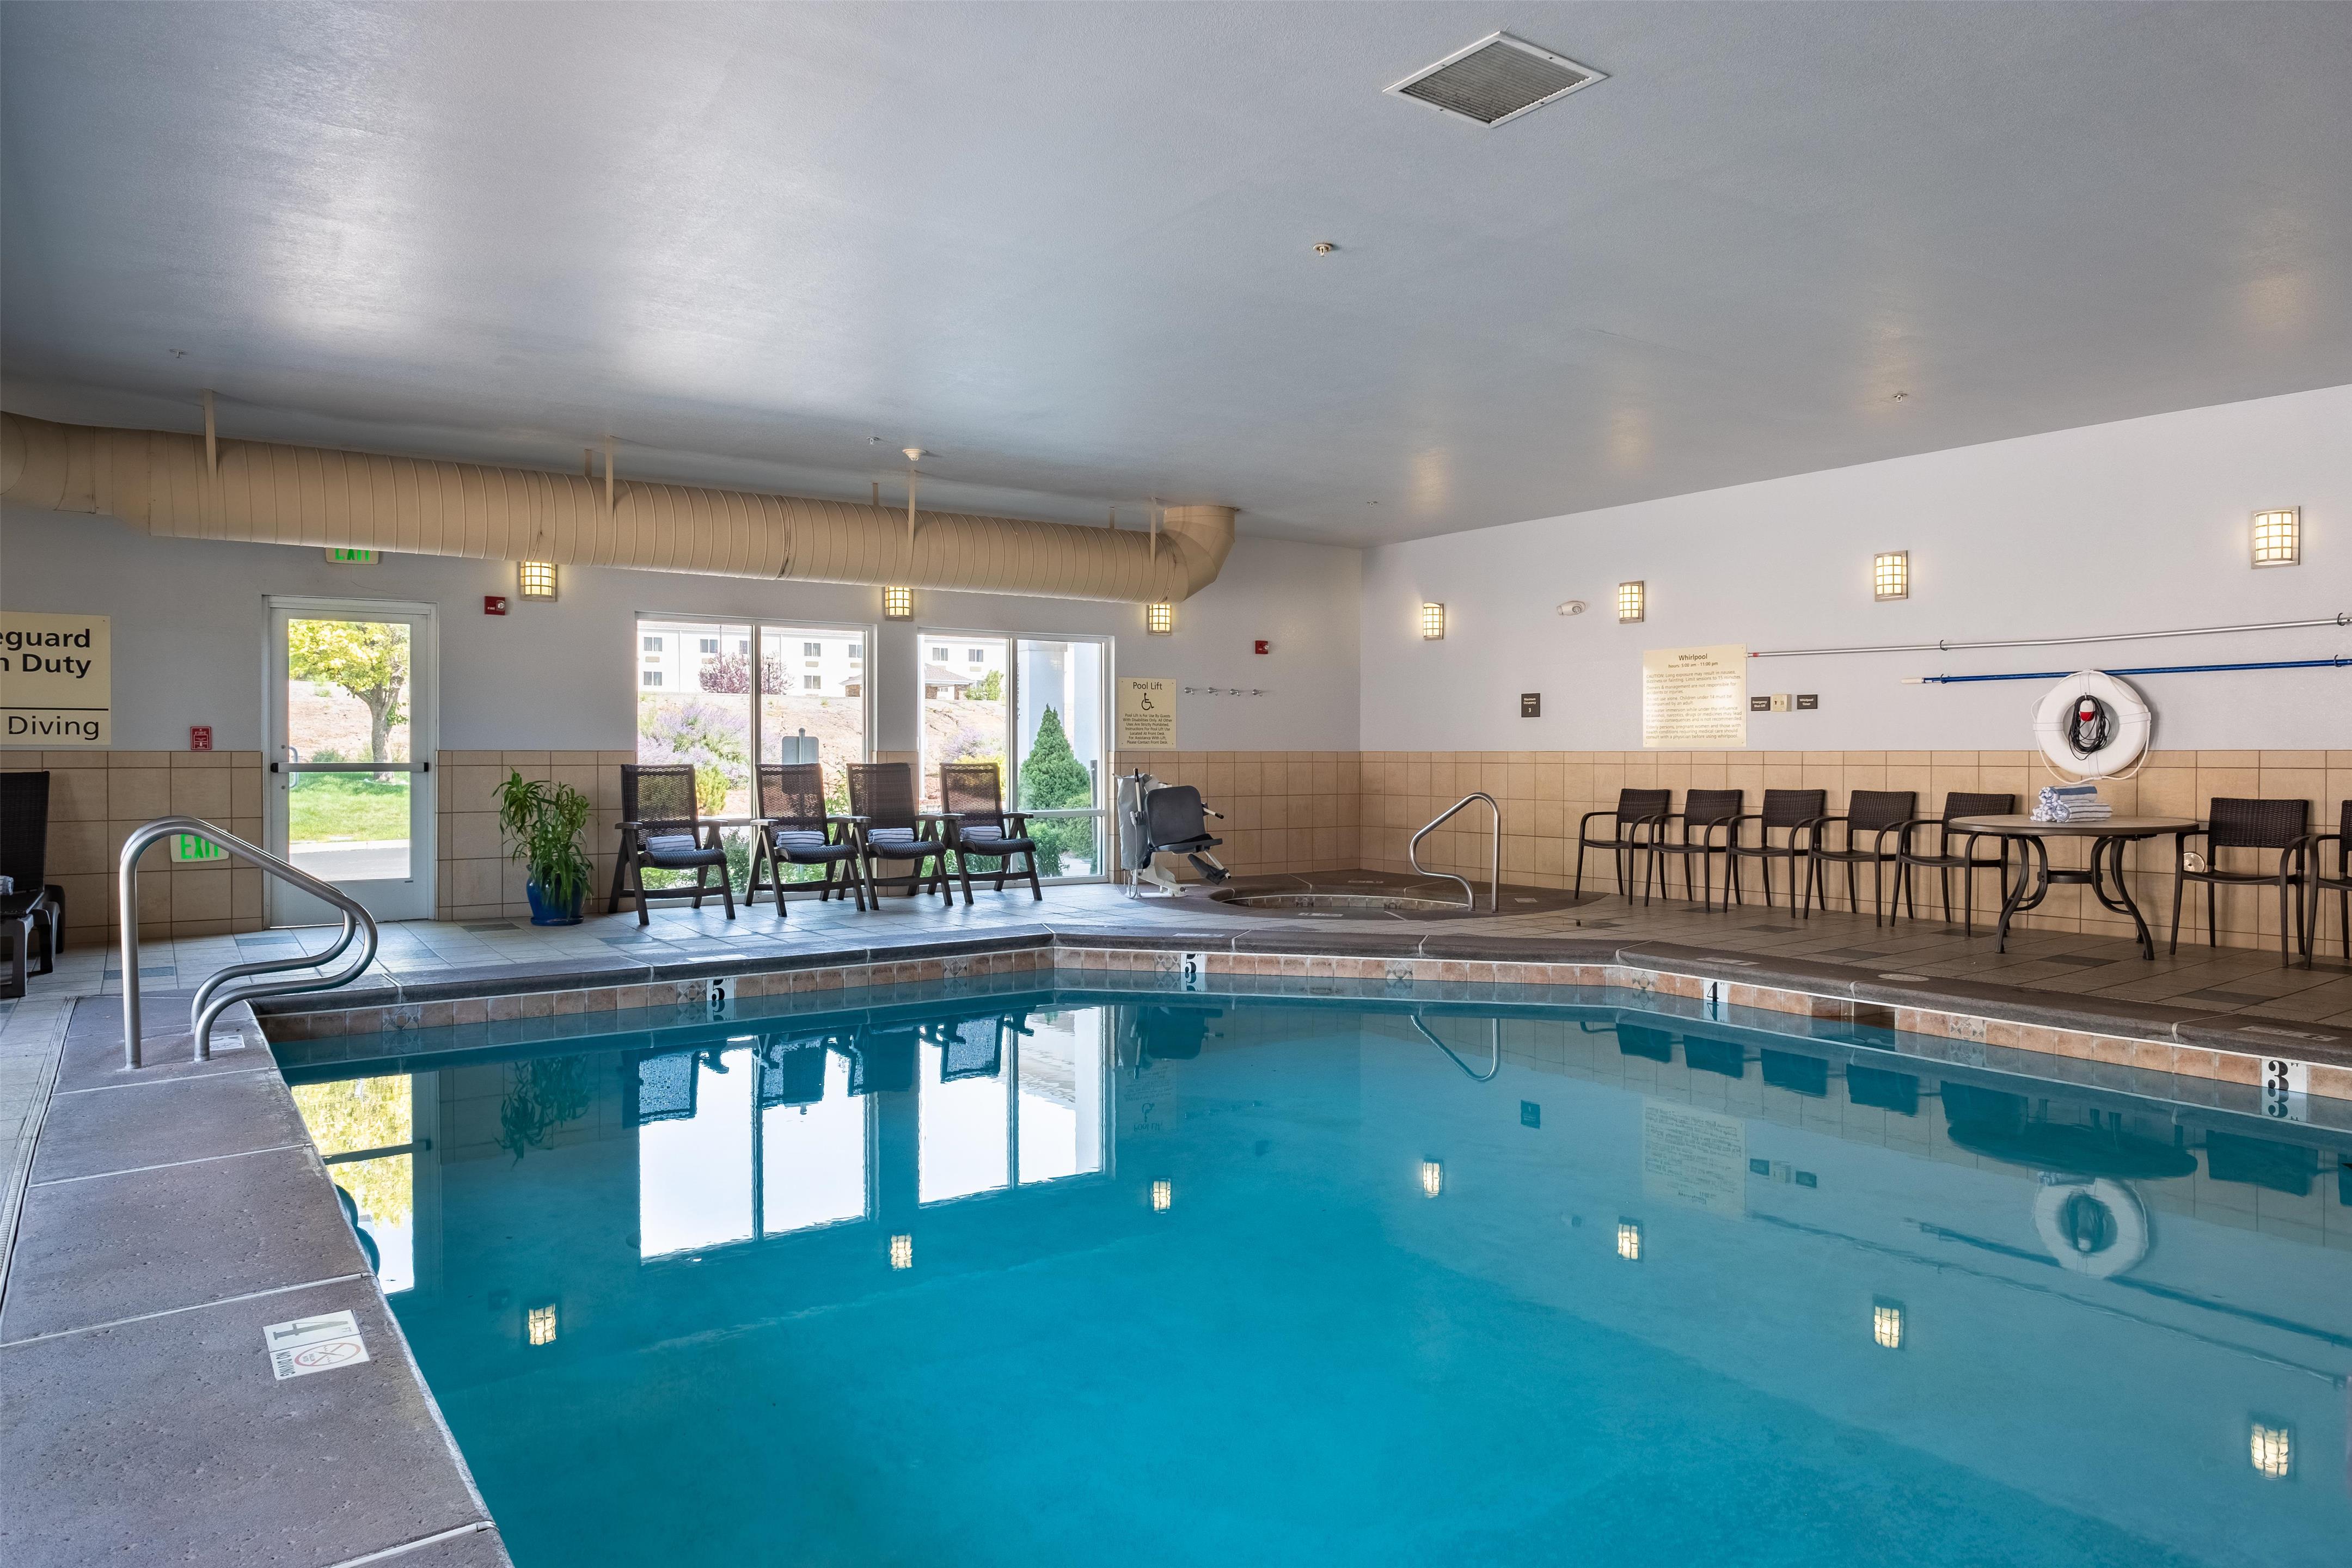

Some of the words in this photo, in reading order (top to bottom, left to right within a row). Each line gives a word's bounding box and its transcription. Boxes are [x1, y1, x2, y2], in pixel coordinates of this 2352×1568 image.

[0, 629, 90, 651] guard
[22, 653, 91, 678] Duty
[9, 715, 99, 740] Diving
[1185, 954, 1197, 973] 5
[712, 979, 725, 1001] 5
[1707, 982, 1719, 1002] 4
[2268, 1060, 2289, 1091] 3
[273, 1321, 348, 1340] 4
[275, 1351, 291, 1359] NO
[277, 1358, 296, 1377] DIVING
